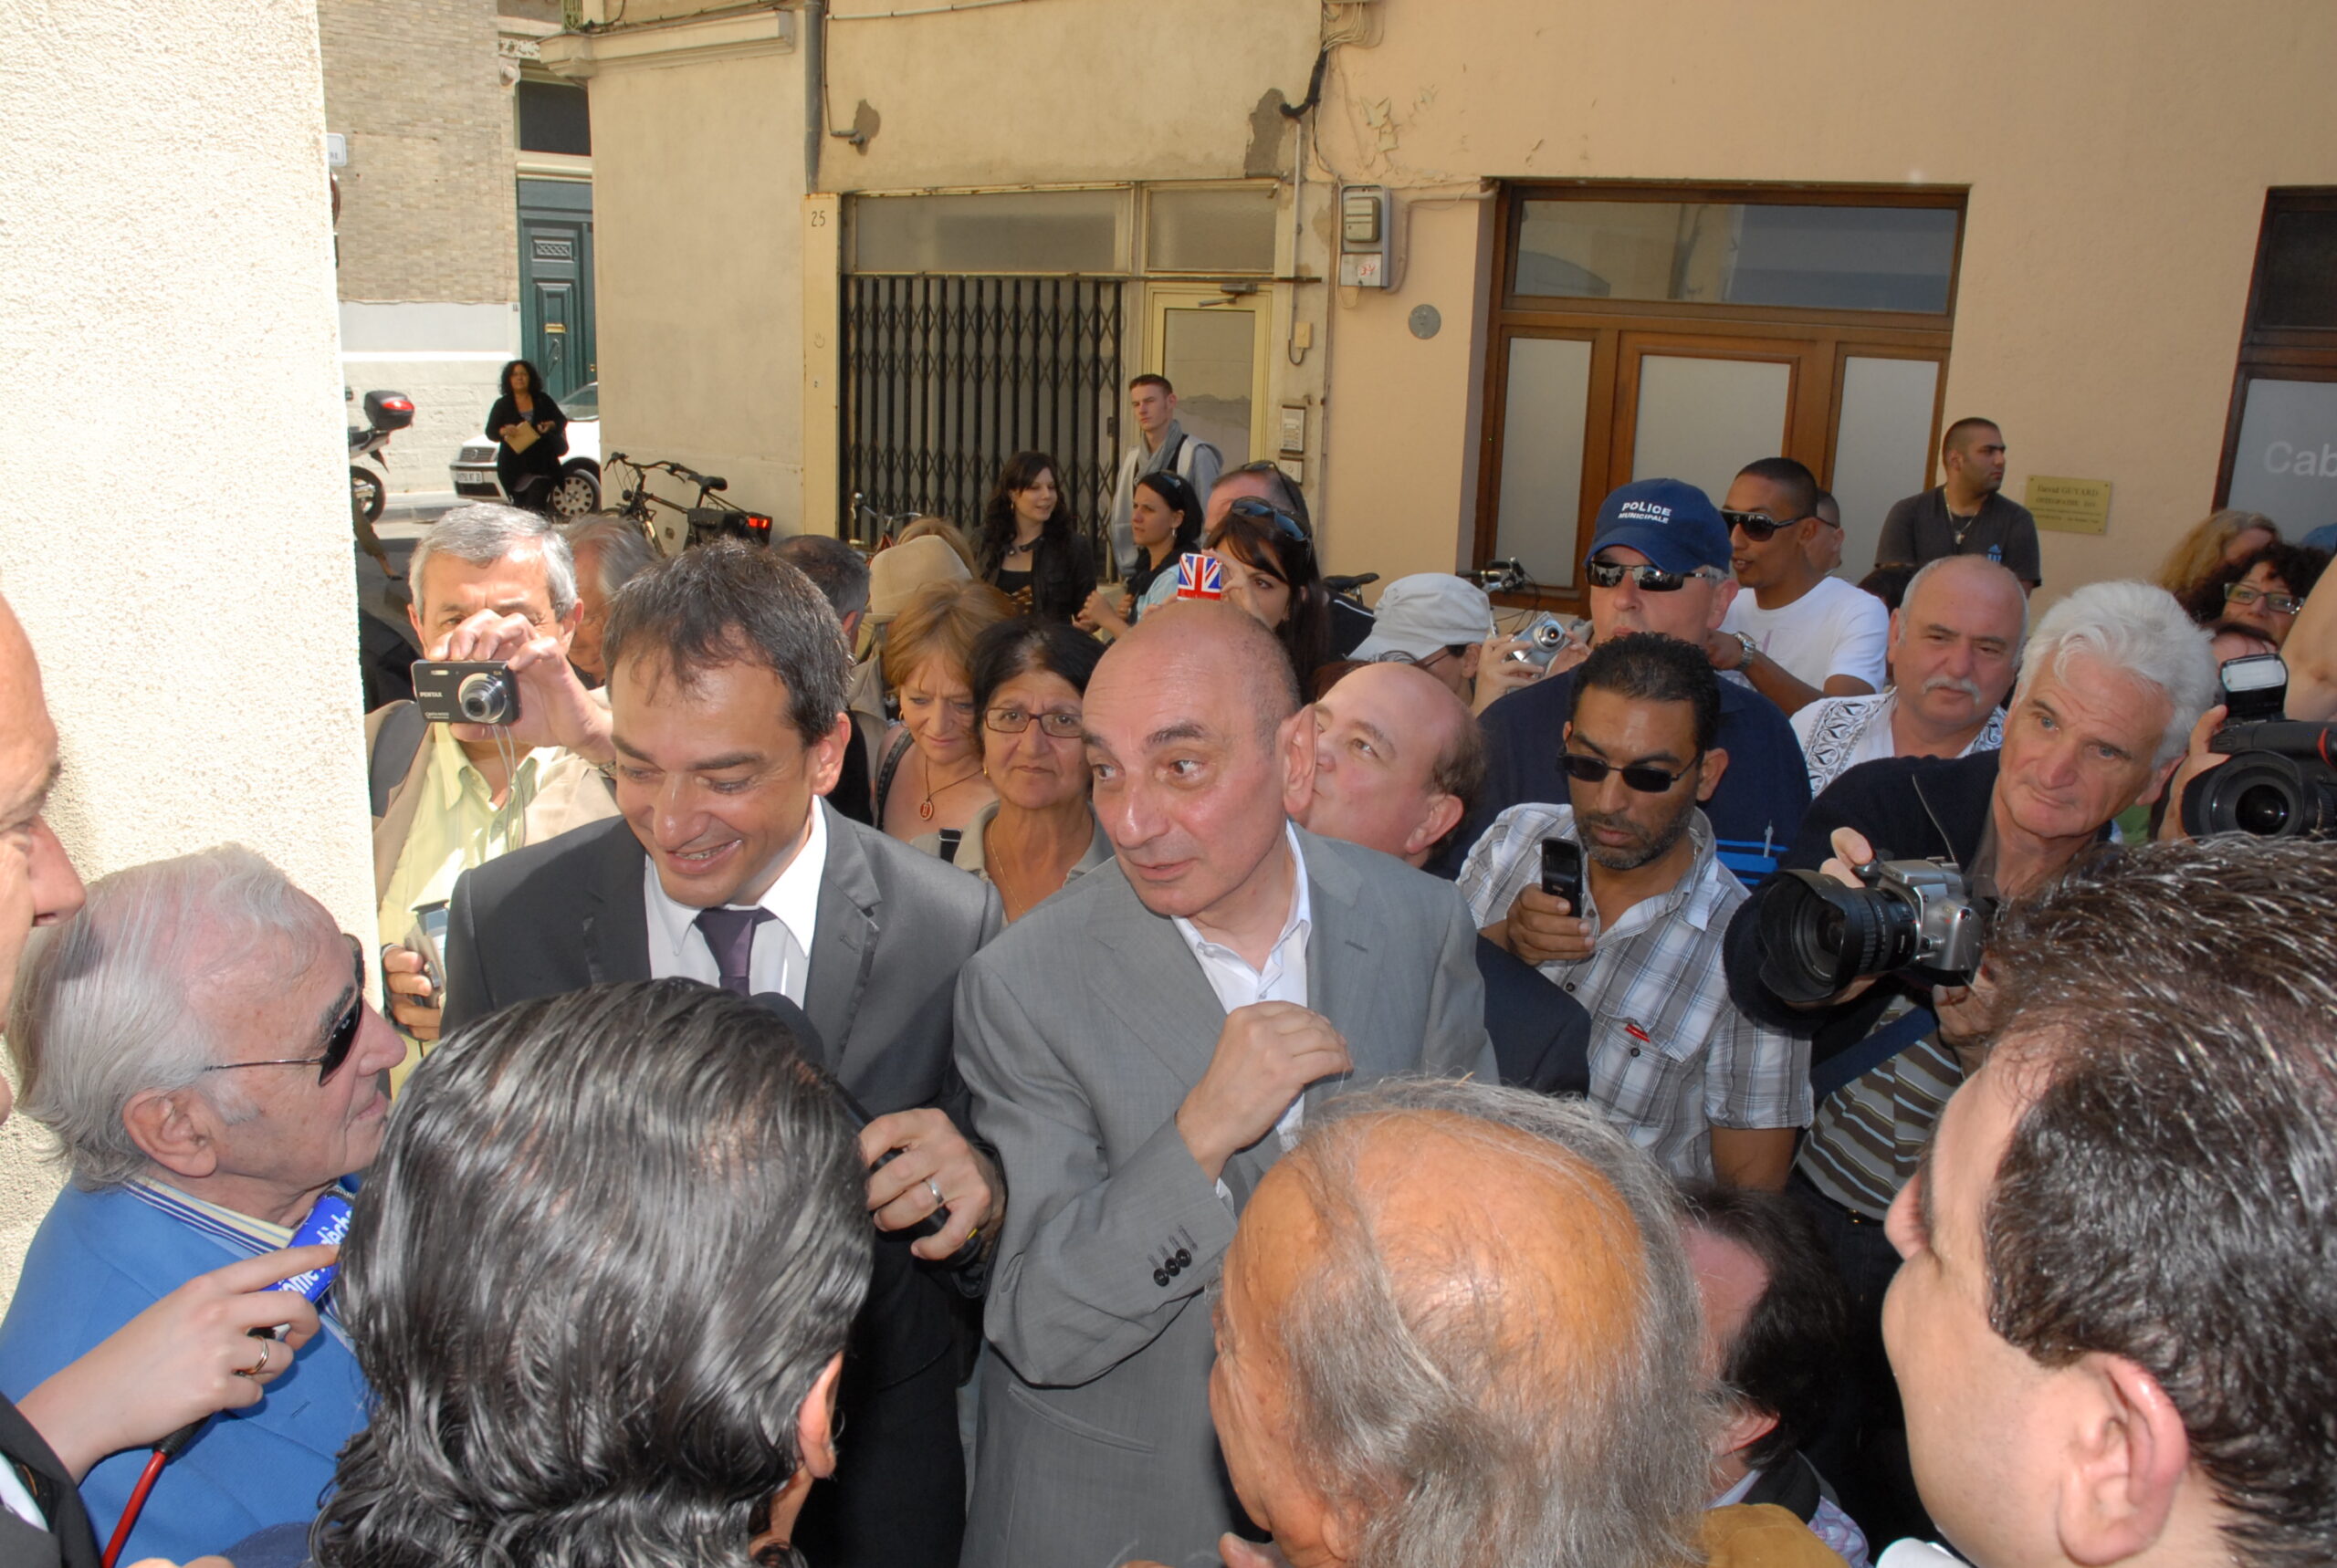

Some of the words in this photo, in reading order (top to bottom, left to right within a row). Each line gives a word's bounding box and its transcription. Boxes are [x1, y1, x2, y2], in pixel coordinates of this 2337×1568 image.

[811, 210, 825, 227] 25
[2264, 441, 2337, 477] Cab
[1621, 501, 1672, 517] POLICE
[1618, 512, 1669, 524] MUNICIPALE
